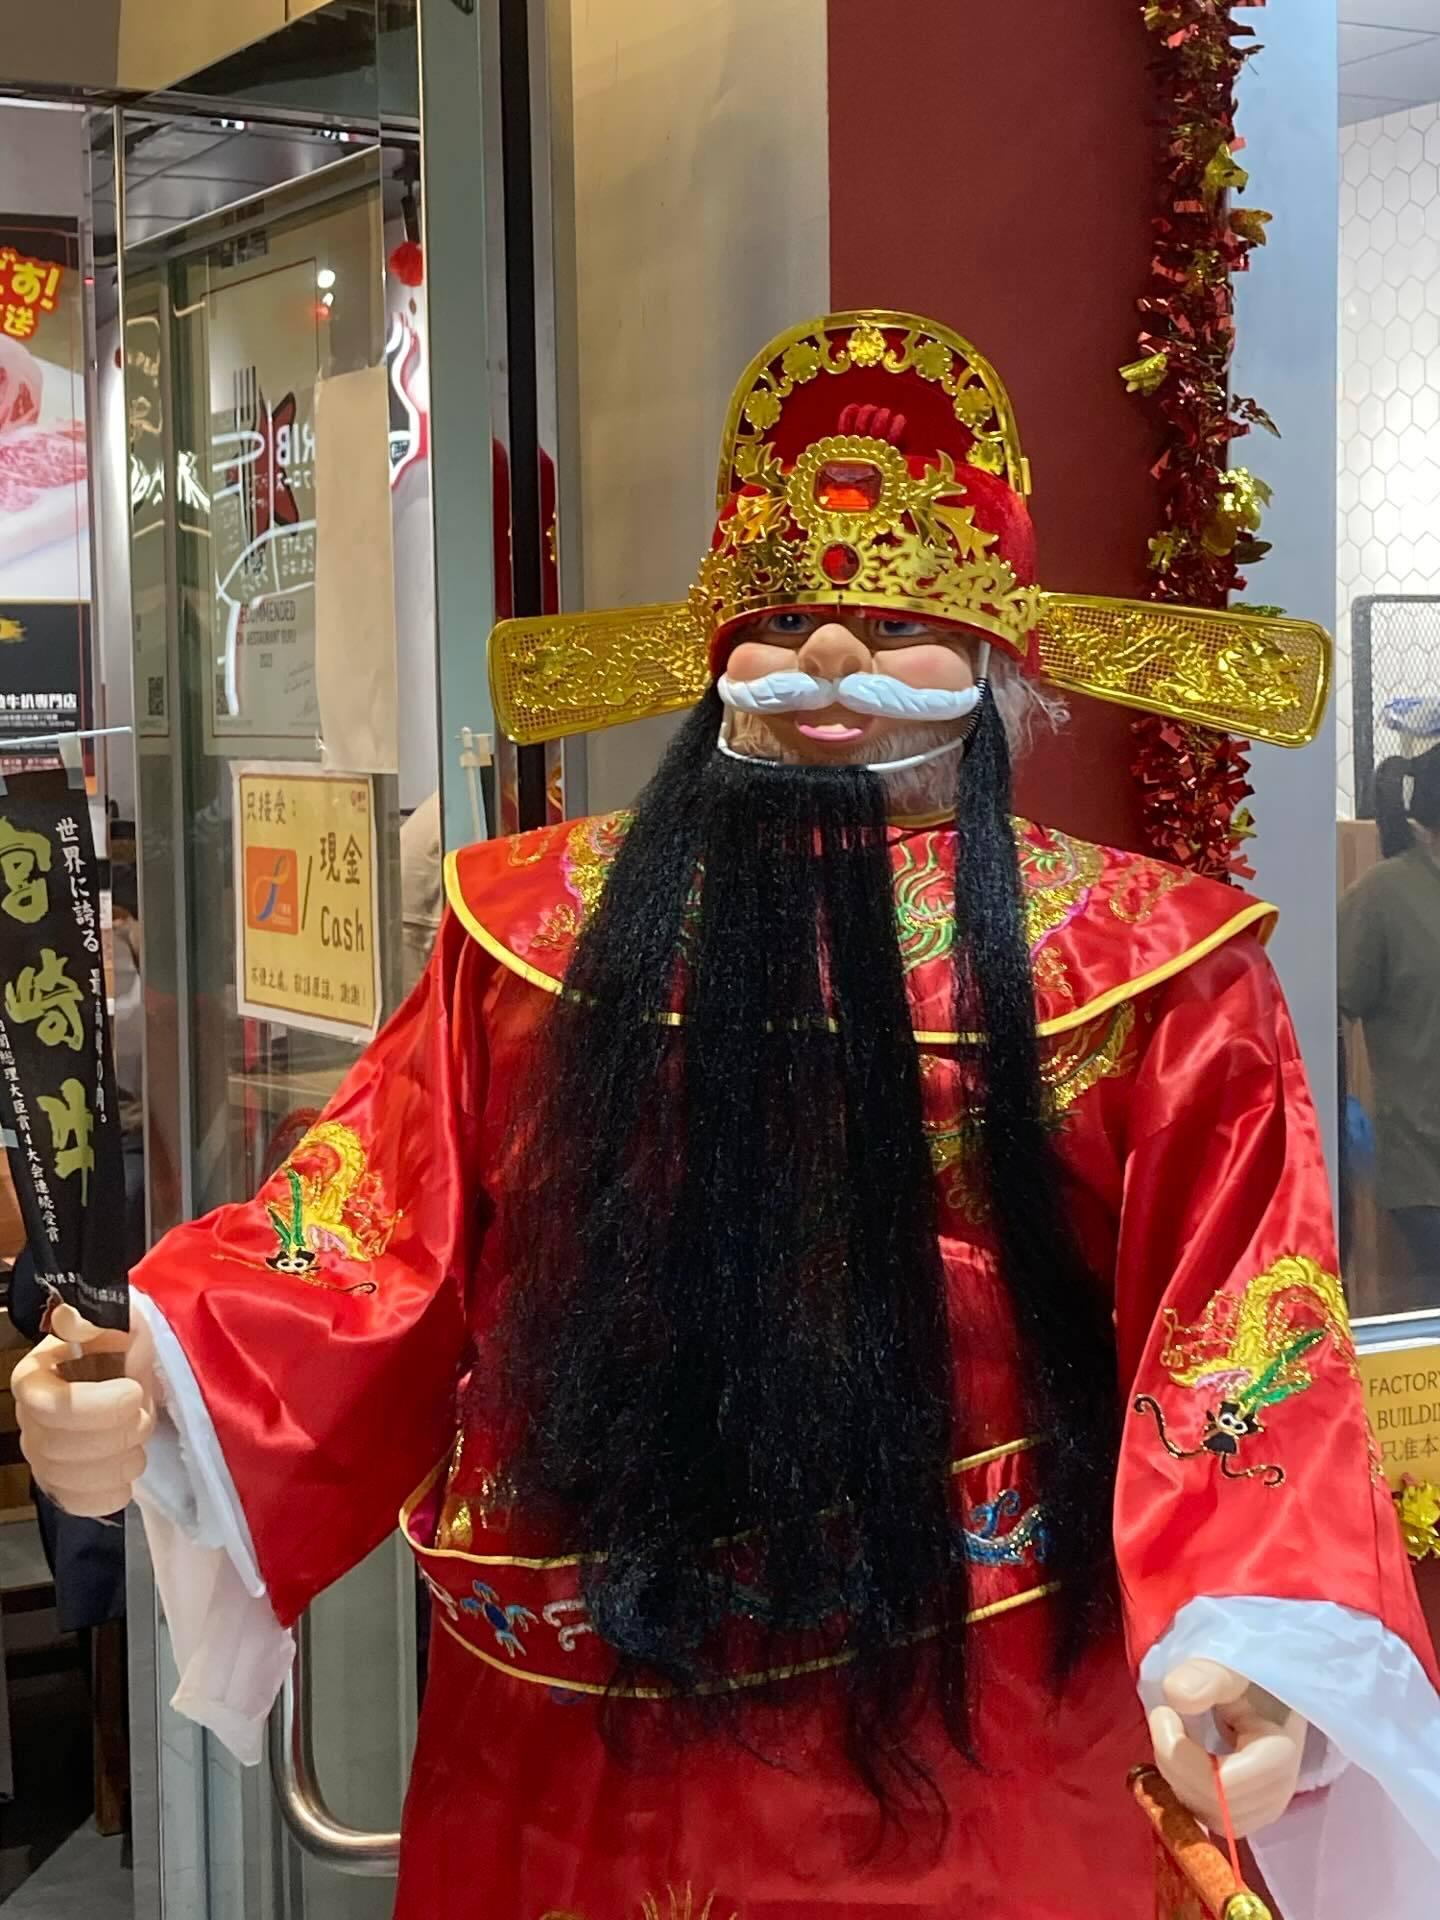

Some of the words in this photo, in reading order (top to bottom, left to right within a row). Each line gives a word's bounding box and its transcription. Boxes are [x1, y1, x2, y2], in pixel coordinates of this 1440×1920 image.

[0, 304, 34, 336] 送
[319, 832, 363, 885] 現金
[320, 905, 365, 952] Cash
[1369, 1370, 1440, 1397] FACTOR
